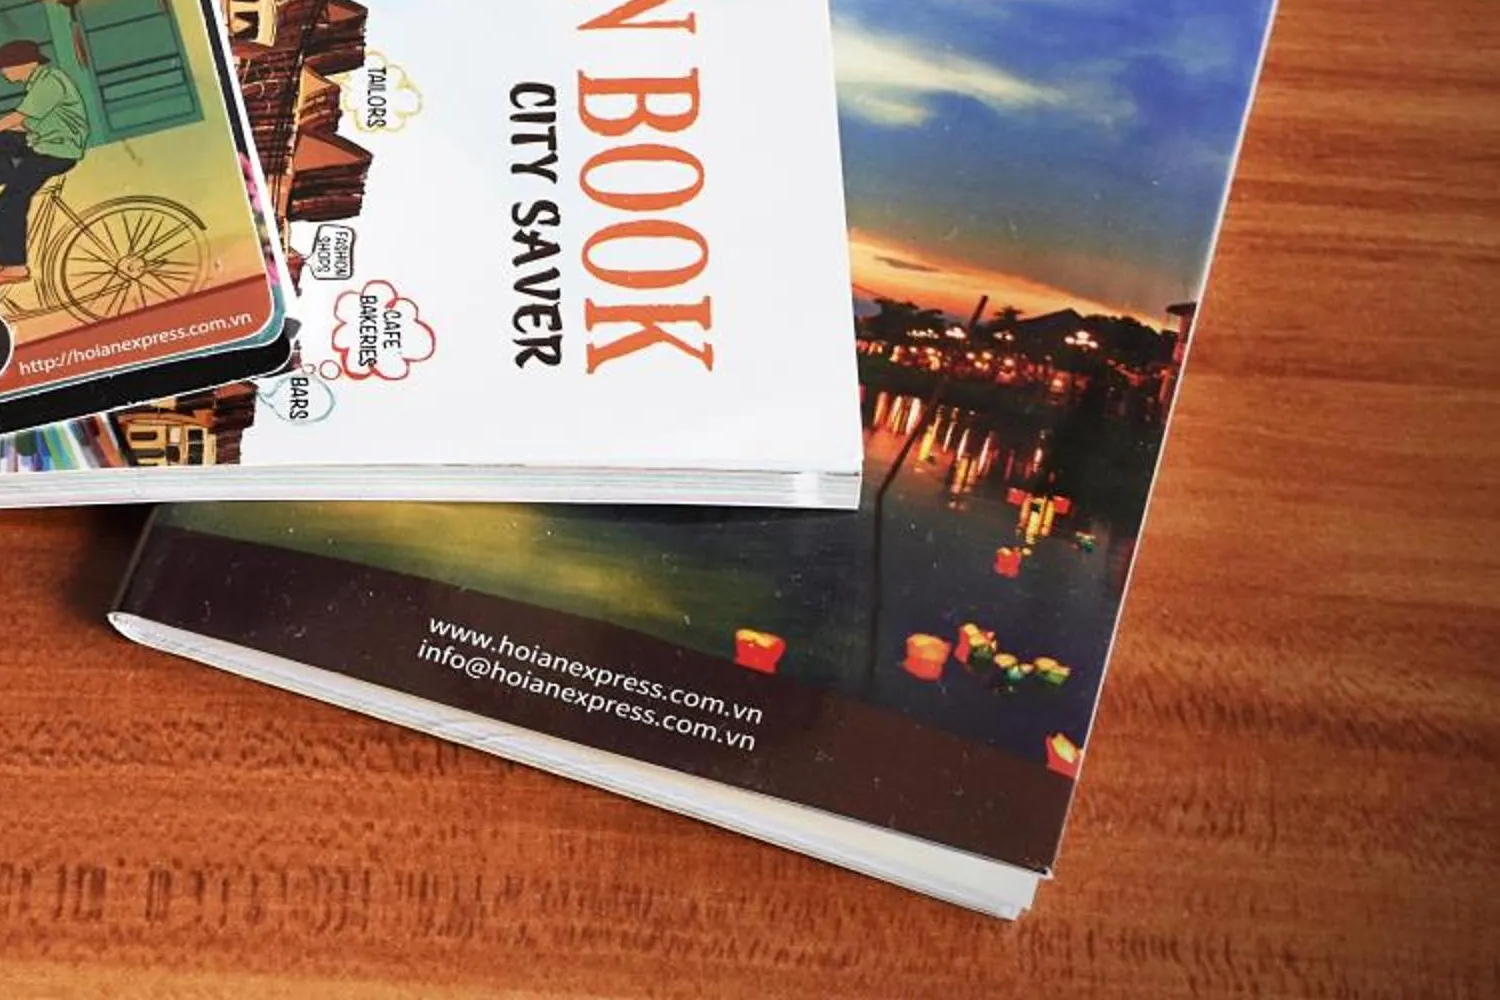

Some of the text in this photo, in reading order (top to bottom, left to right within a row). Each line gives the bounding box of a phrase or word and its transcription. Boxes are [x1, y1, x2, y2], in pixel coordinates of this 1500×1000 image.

[365, 67, 387, 129] TAILORS
[316, 236, 331, 274] SHOPS
[336, 230, 350, 279] FASHION
[509, 82, 564, 369] CITY SAVER
[576, 68, 714, 375] BOOK
[18, 310, 254, 378] http://hoianexpress.com.vn
[359, 295, 377, 368] BAKERIES
[289, 376, 309, 420] BARS
[418, 640, 756, 752] info@hoianexpress.com.vn
[429, 617, 764, 725] www.hoianexpress.com.vn
